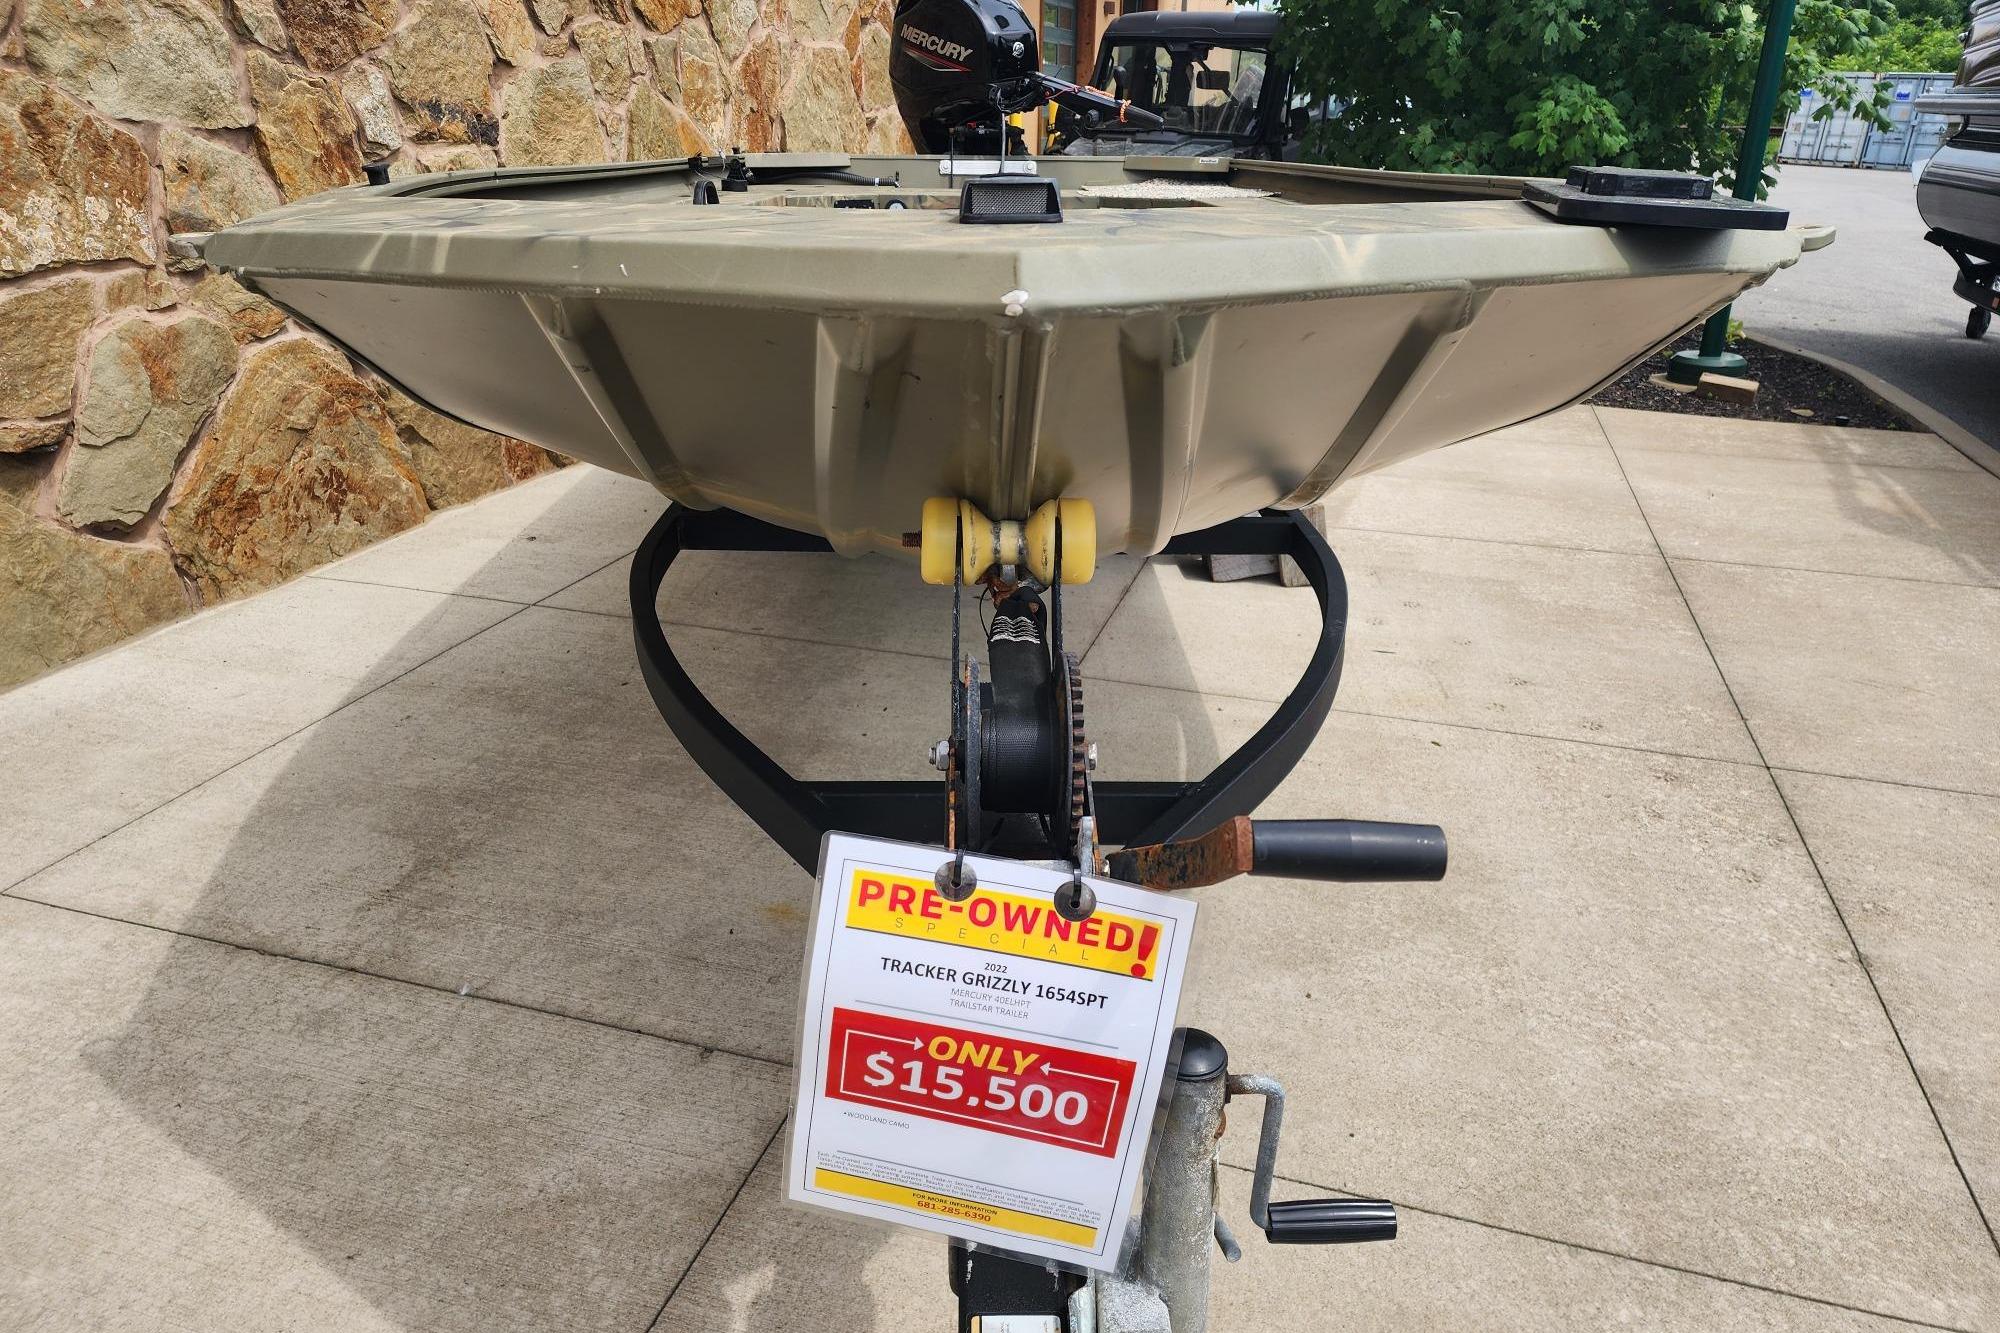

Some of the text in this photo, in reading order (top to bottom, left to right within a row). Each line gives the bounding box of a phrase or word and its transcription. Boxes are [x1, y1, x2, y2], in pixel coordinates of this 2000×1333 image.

[900, 24, 973, 61] MERCURY
[984, 962, 1008, 974] 2022
[881, 957, 1108, 1009] TRACKER GRIZZLY 1654SPT
[951, 988, 992, 1002] MERCURY
[950, 998, 1029, 1019] TRAILSTAR TRAILER
[928, 1036, 1040, 1075] ONLY
[912, 1192, 998, 1216] FOR MORE INFORMATION
[917, 1200, 991, 1222] 681-285-6390
